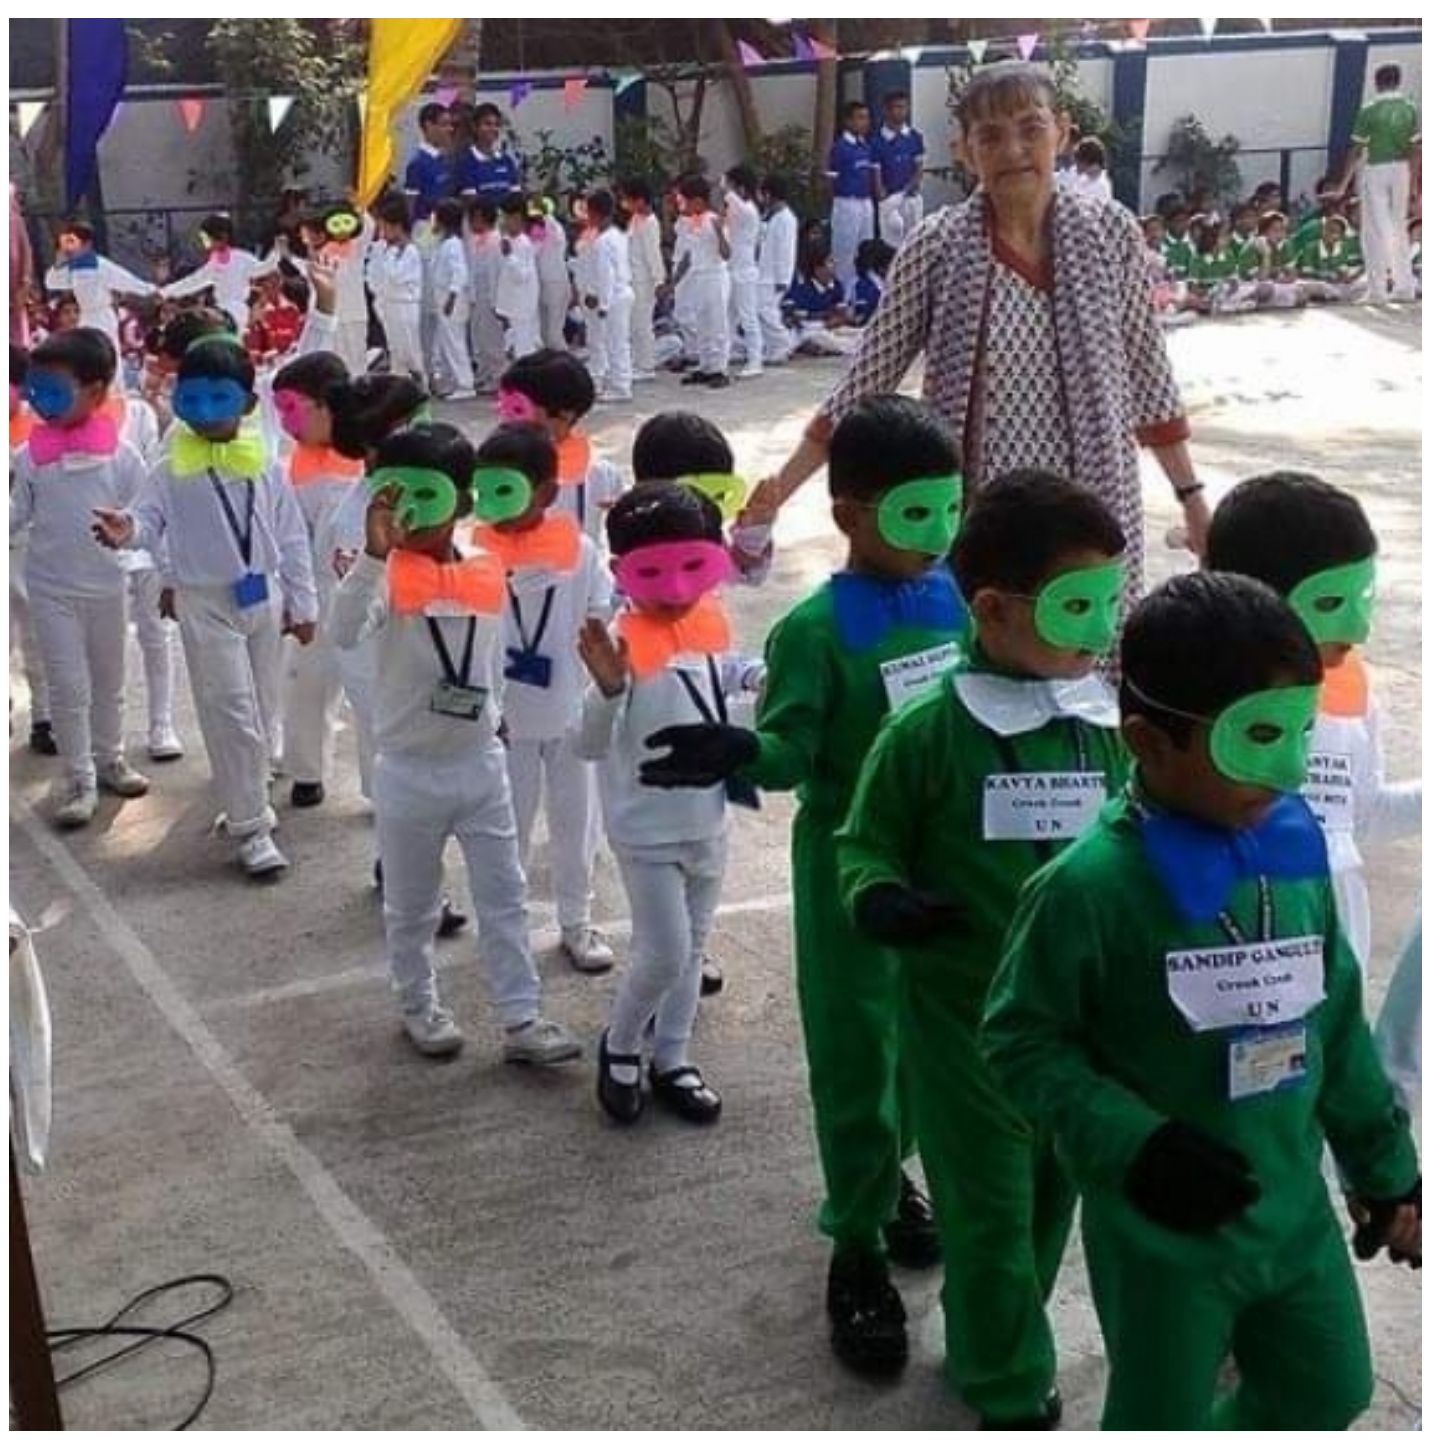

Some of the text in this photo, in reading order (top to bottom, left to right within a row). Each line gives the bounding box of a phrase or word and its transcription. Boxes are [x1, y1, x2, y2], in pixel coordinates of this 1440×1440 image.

[1035, 819, 1062, 832] U N
[1167, 951, 1247, 972] SANDIP
[1247, 999, 1279, 1017] U N
